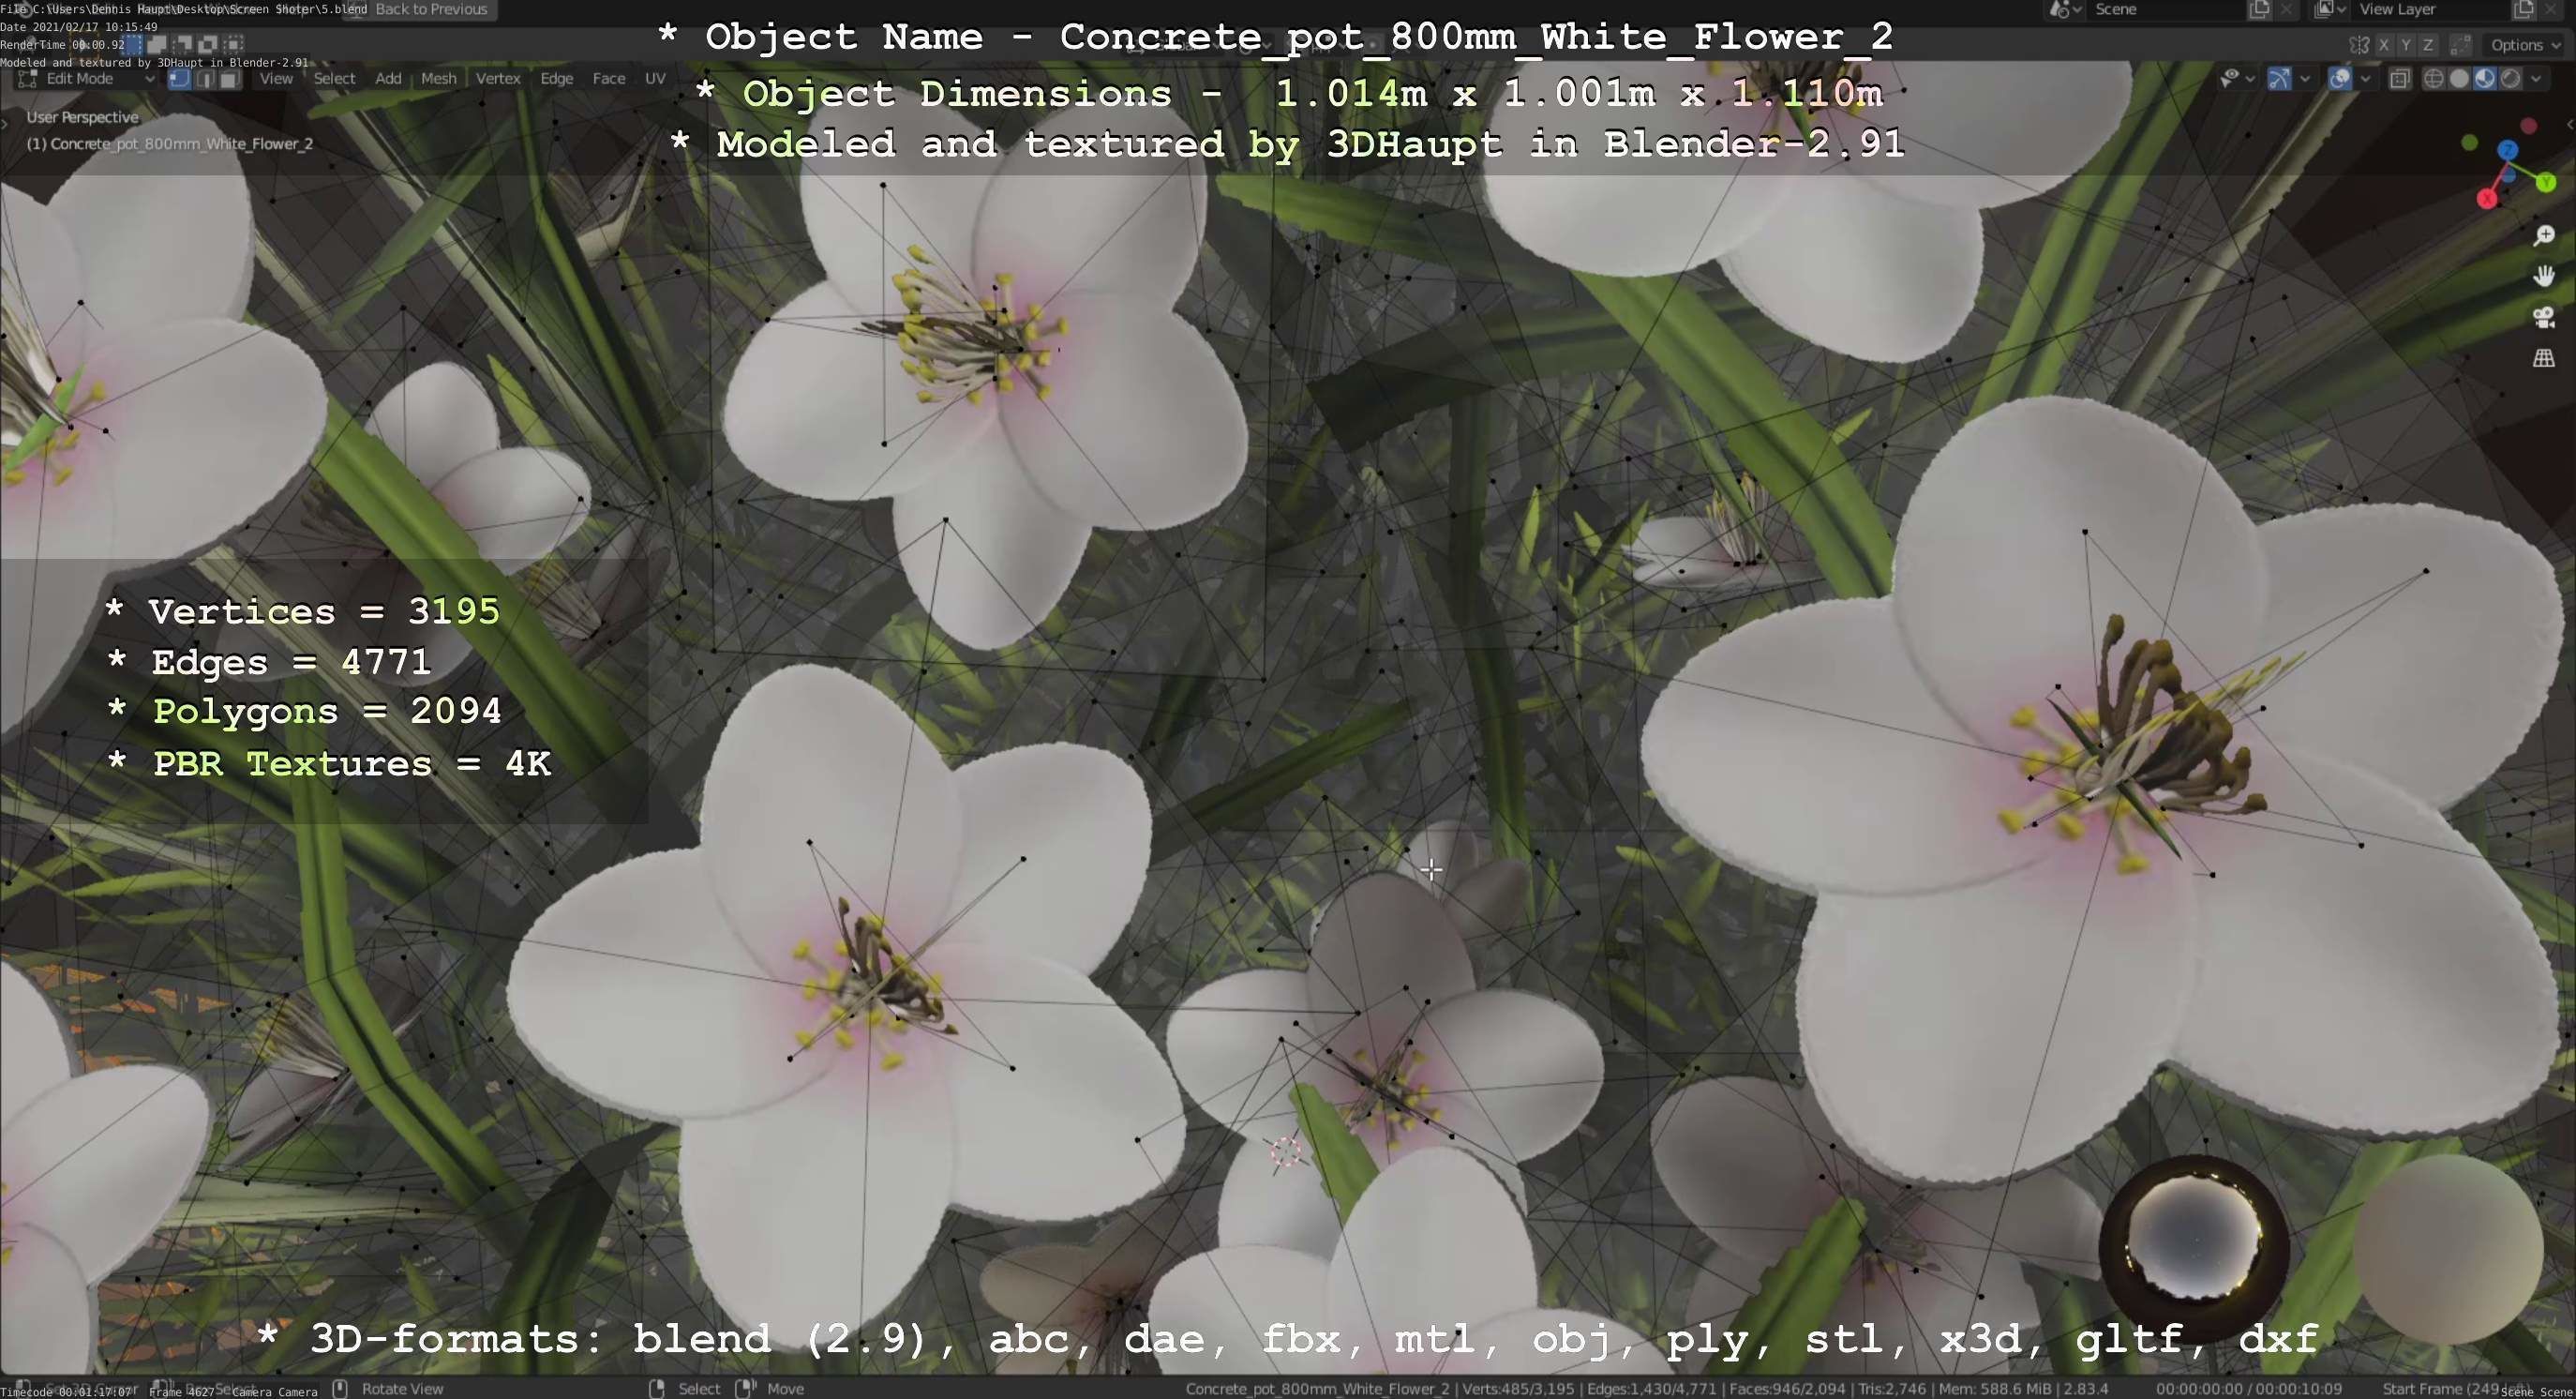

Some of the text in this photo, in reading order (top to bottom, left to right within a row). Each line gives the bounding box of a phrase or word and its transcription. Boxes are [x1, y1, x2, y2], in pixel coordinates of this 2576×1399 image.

[377, 4, 487, 15] Back to Previous
[2096, 4, 2137, 15] Scene
[2360, 4, 2436, 18] View Layer
[2379, 39, 2434, 51] X Y Z
[2492, 39, 2543, 54] Options
[48, 72, 112, 84] Edit Mode
[261, 73, 293, 85] View
[314, 73, 356, 85] Select
[376, 73, 402, 85] Add
[422, 73, 457, 85] Mesh
[476, 73, 521, 85] Vertex
[541, 73, 574, 89] Edge
[593, 73, 626, 85] Face
[646, 73, 666, 85] UV
[27, 112, 139, 128] User Perspective
[27, 138, 313, 154] (1) Concrete_pot_800mm_White_Flower_2
[363, 1383, 443, 1395] Rotate View
[679, 1383, 721, 1395] Select
[768, 1383, 804, 1395] Move
[1186, 1382, 1449, 1398] Concrete_pot_800mm_White_Flower_2
[1462, 1382, 1575, 1396] Verts:485/3,195
[1588, 1382, 1716, 1398] Edges:1,430/4,771
[1730, 1382, 1845, 1396] Faces:946/2,094
[1859, 1382, 1926, 1396] Tris:2,746
[1939, 1382, 1977, 1395] Mem:
[1981, 1382, 2022, 1395] 588.6
[2027, 1382, 2052, 1395] MiB
[2064, 1382, 2108, 1395] 2.83.4
[2156, 1382, 2242, 1395] 00:00:00:00
[2256, 1382, 2343, 1395] 00:00:10:09
[2384, 1383, 2415, 1395] Start
[2419, 1383, 2463, 1395] Frame
[2467, 1382, 2498, 1398] (249
